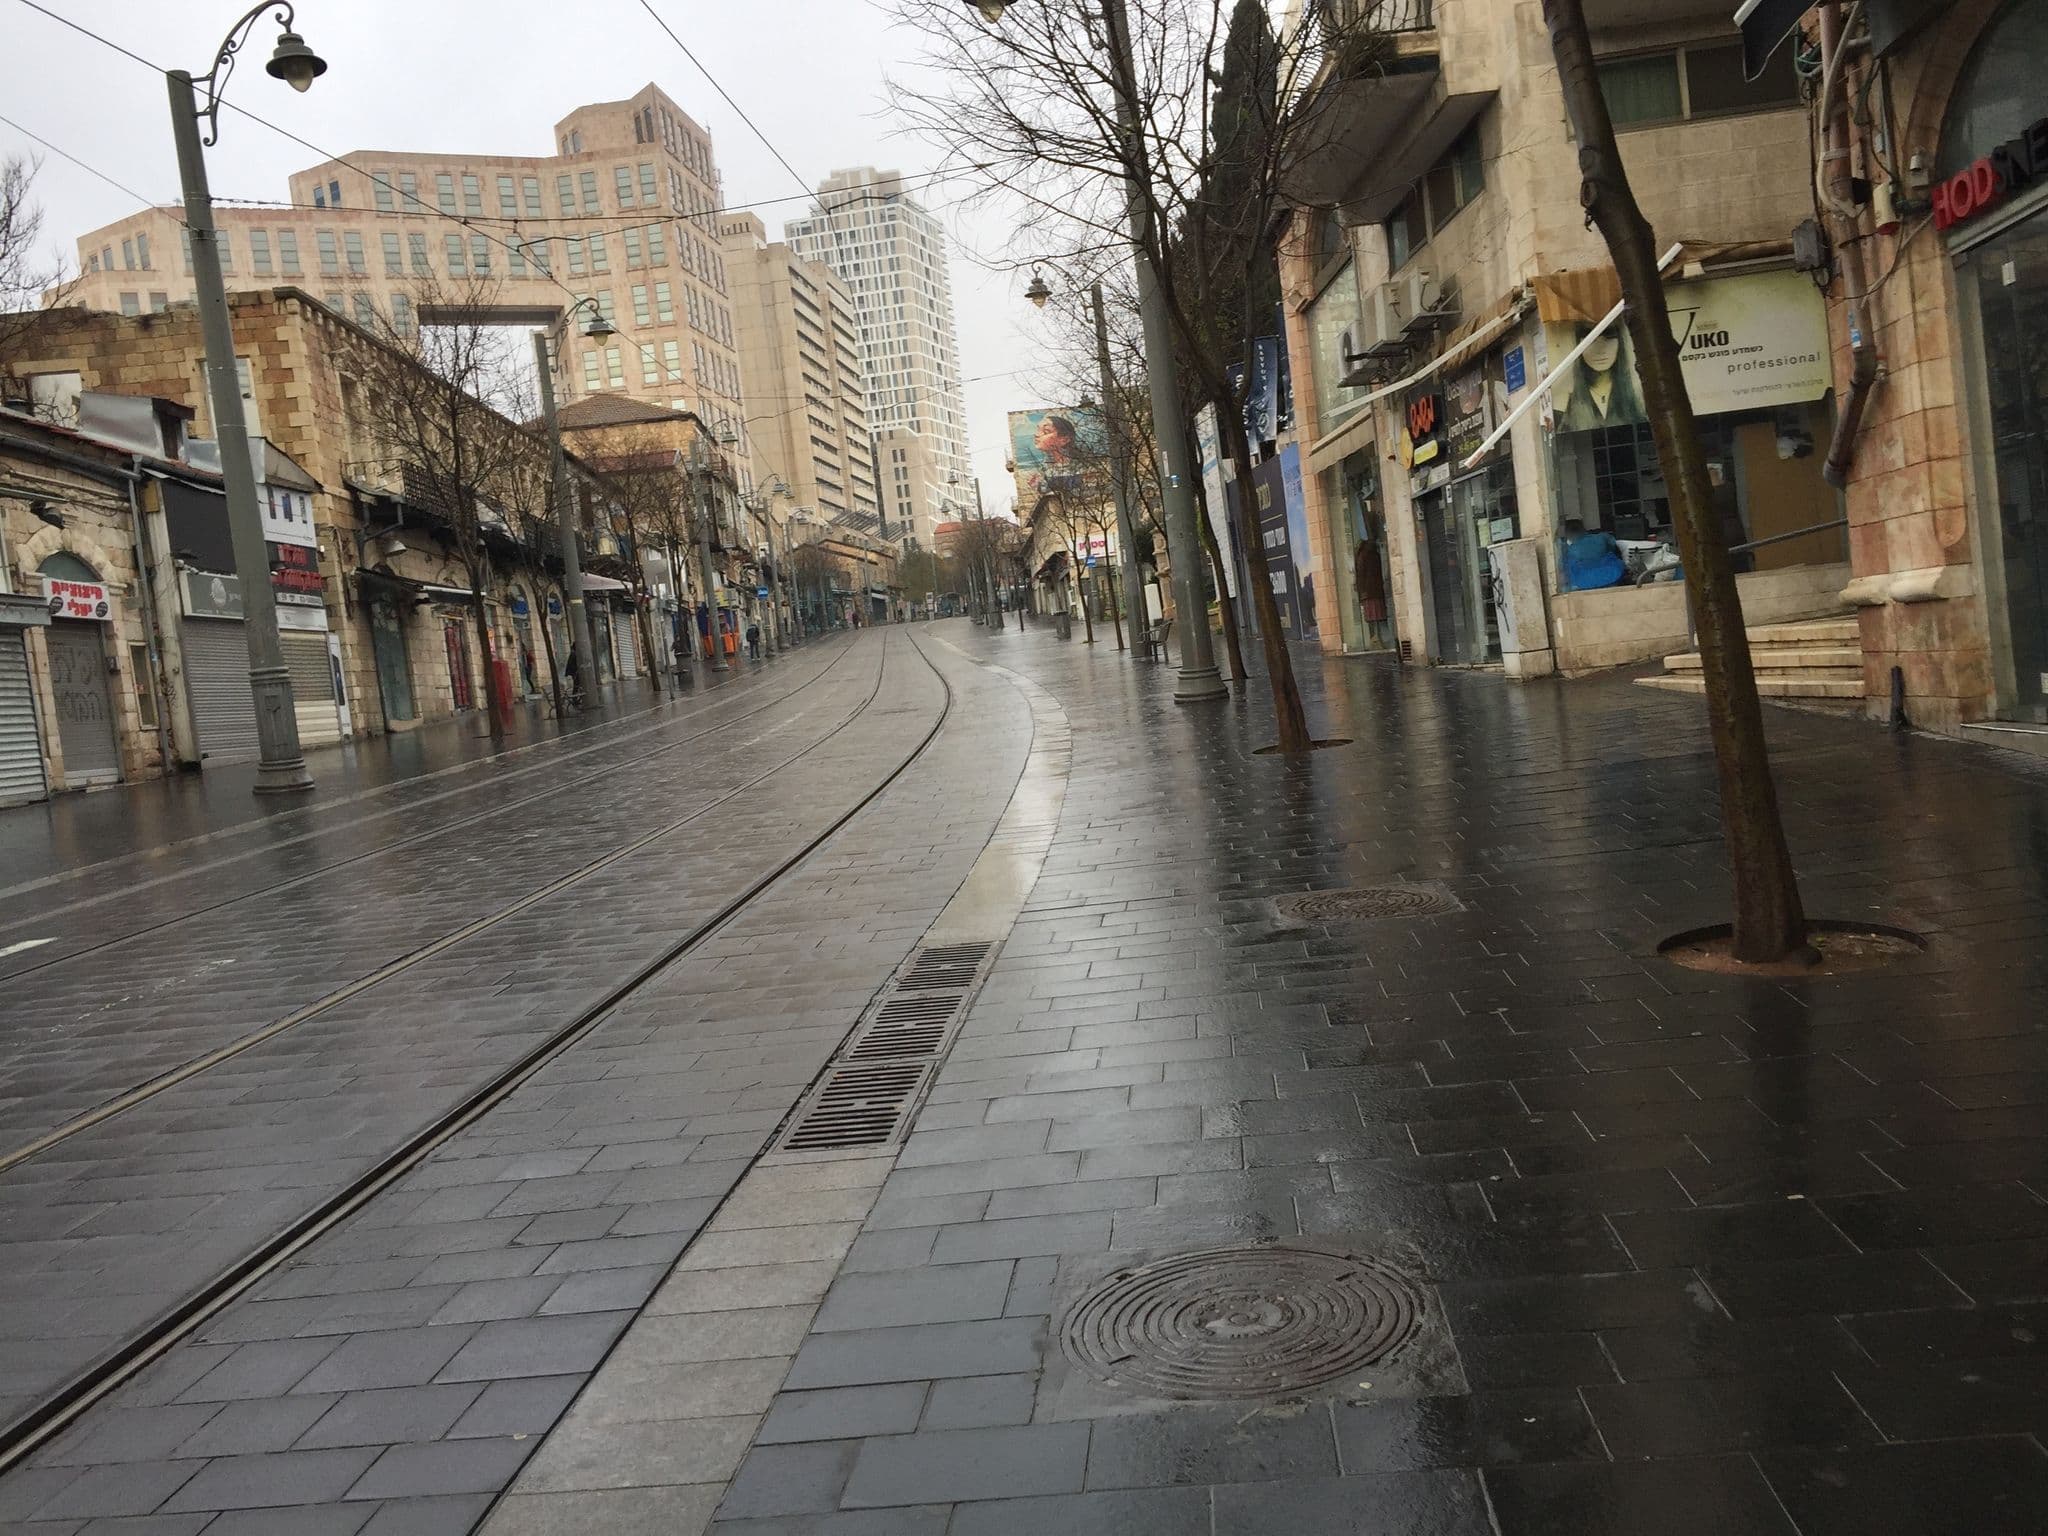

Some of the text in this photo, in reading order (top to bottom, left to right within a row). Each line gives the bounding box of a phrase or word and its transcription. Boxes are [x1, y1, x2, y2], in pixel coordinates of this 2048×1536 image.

[1931, 157, 1993, 232] HOD
[1732, 345, 1764, 355] כשמדע
[1727, 352, 1821, 375] professional
